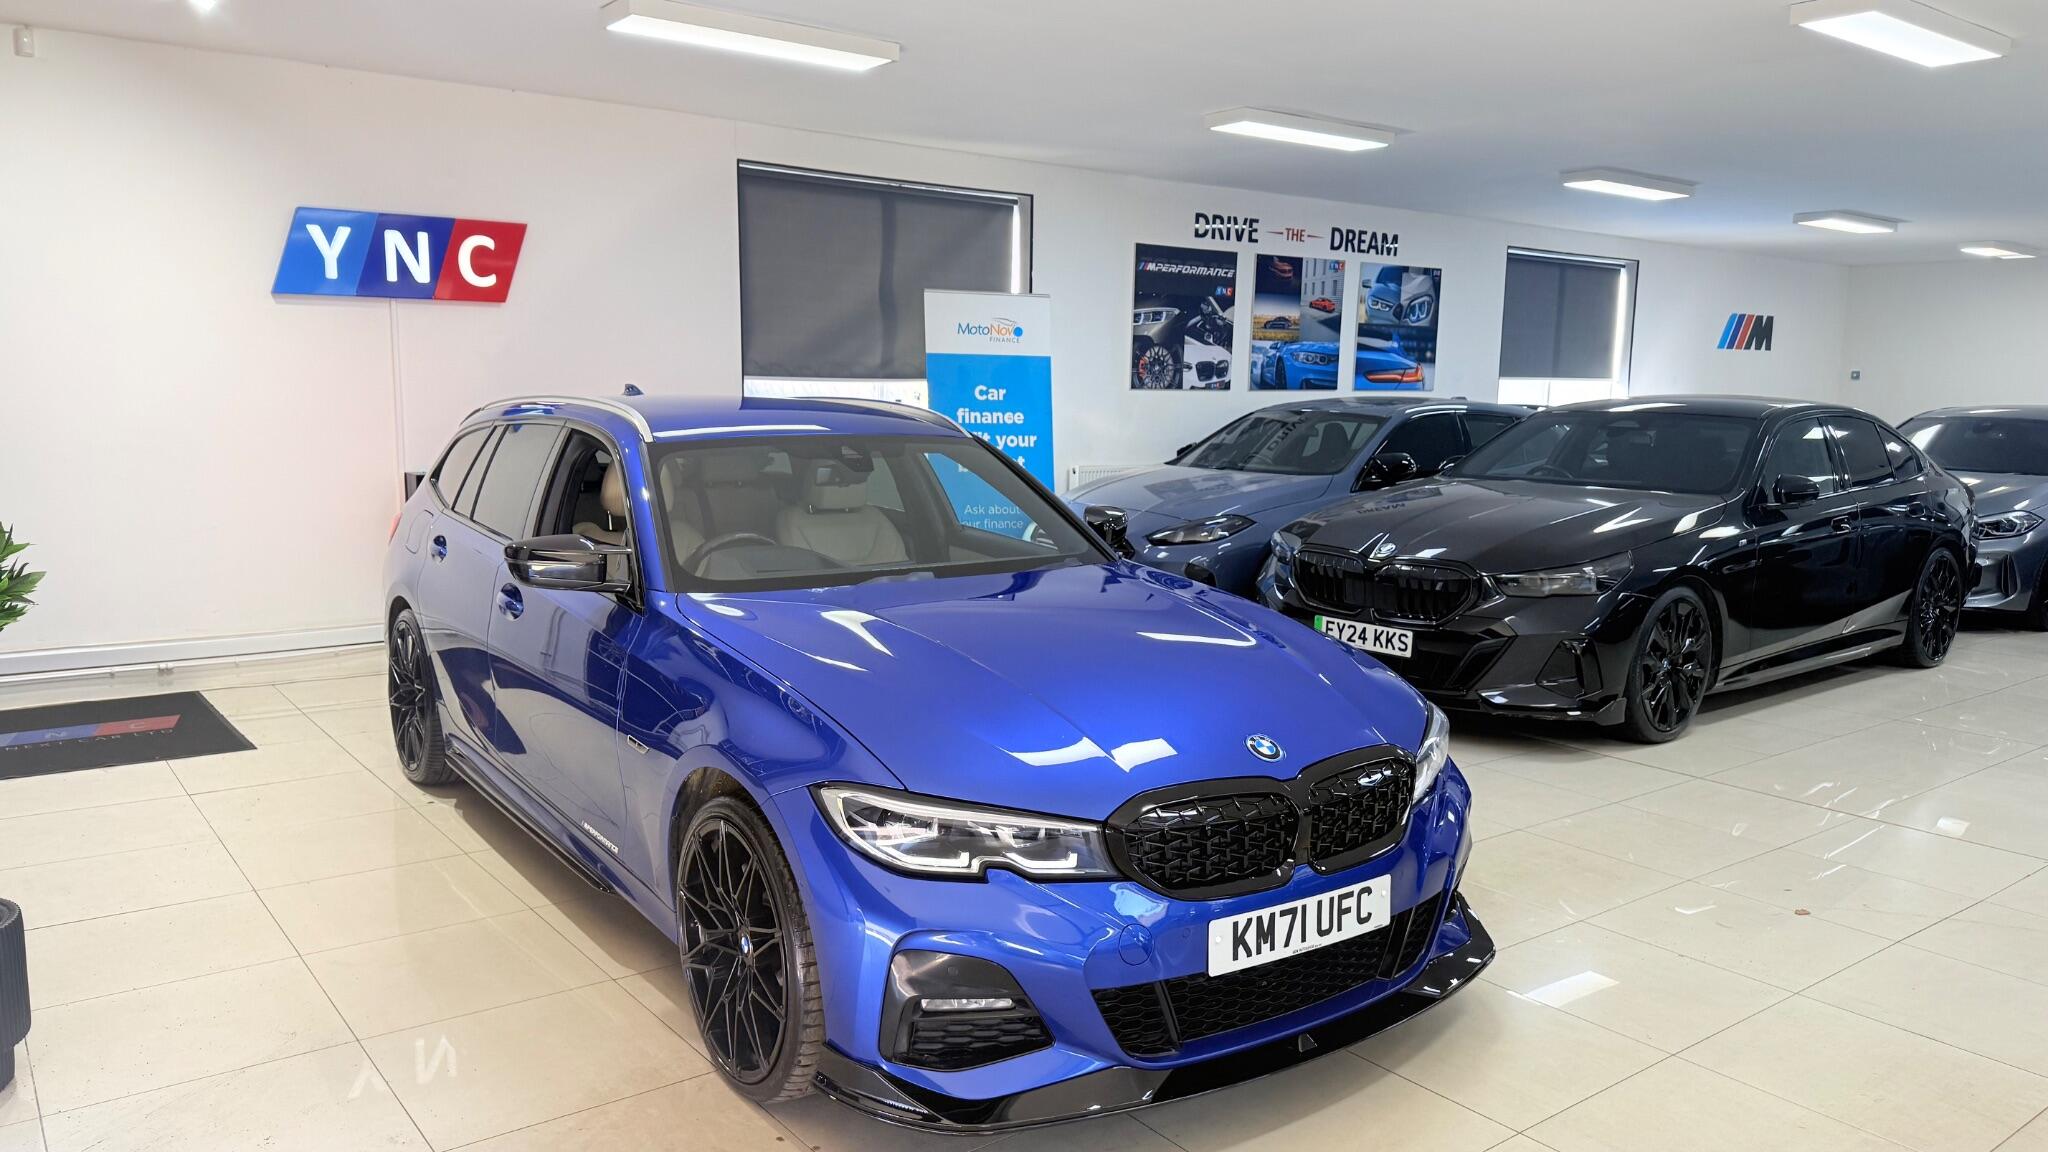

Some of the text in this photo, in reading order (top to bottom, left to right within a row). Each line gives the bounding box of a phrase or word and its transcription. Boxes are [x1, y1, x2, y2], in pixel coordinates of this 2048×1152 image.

[1194, 212, 1399, 256] DRIVE THE DREAM
[306, 224, 497, 287] YNC
[989, 336, 1020, 344] FINANCE
[974, 385, 1006, 401] Car
[956, 408, 1024, 424] finance
[996, 434, 1037, 449] your
[964, 505, 1021, 515] Ask about
[984, 519, 1023, 529] finance
[1373, 629, 1409, 652] KKS
[1232, 886, 1373, 961] KM71 UFC
